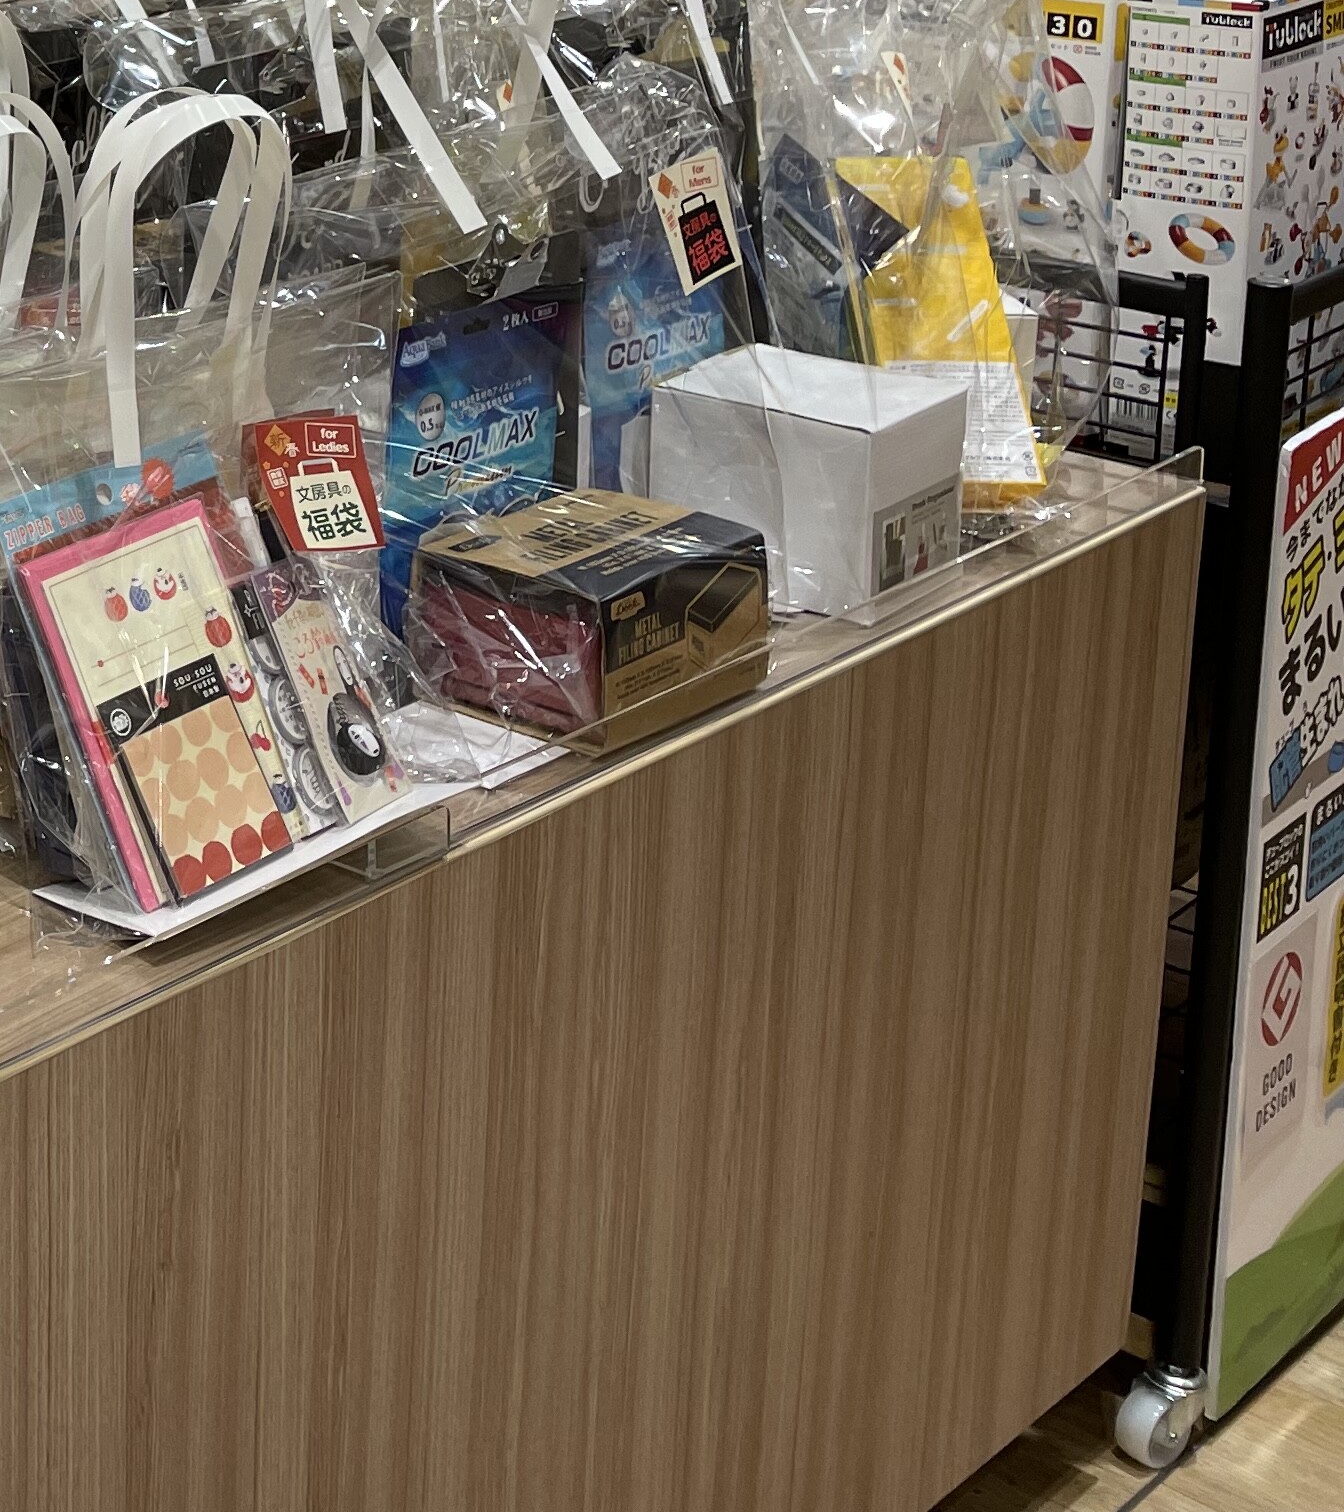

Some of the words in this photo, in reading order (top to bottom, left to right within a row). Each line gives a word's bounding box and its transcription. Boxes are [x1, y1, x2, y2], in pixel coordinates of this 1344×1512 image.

[1204, 13, 1251, 28] Tublock
[1265, 8, 1323, 51] Tublock
[689, 176, 712, 188] Mens
[692, 164, 705, 175] for
[688, 227, 728, 276] 福袋
[605, 313, 713, 372] COOLMAX
[312, 441, 349, 453] Ledies
[320, 428, 339, 439] for
[413, 410, 540, 478] COOLMAX
[296, 481, 352, 503] 文房具の
[3, 519, 53, 550] ZIPPER
[59, 503, 85, 530] BAG
[301, 501, 367, 542] 福袋
[587, 510, 660, 542] CABINET
[618, 637, 646, 667] FILING
[645, 622, 680, 653] CABINET
[634, 612, 662, 637] METAL
[1262, 1052, 1293, 1097] GOOD
[1256, 1079, 1297, 1134] DESIGN
